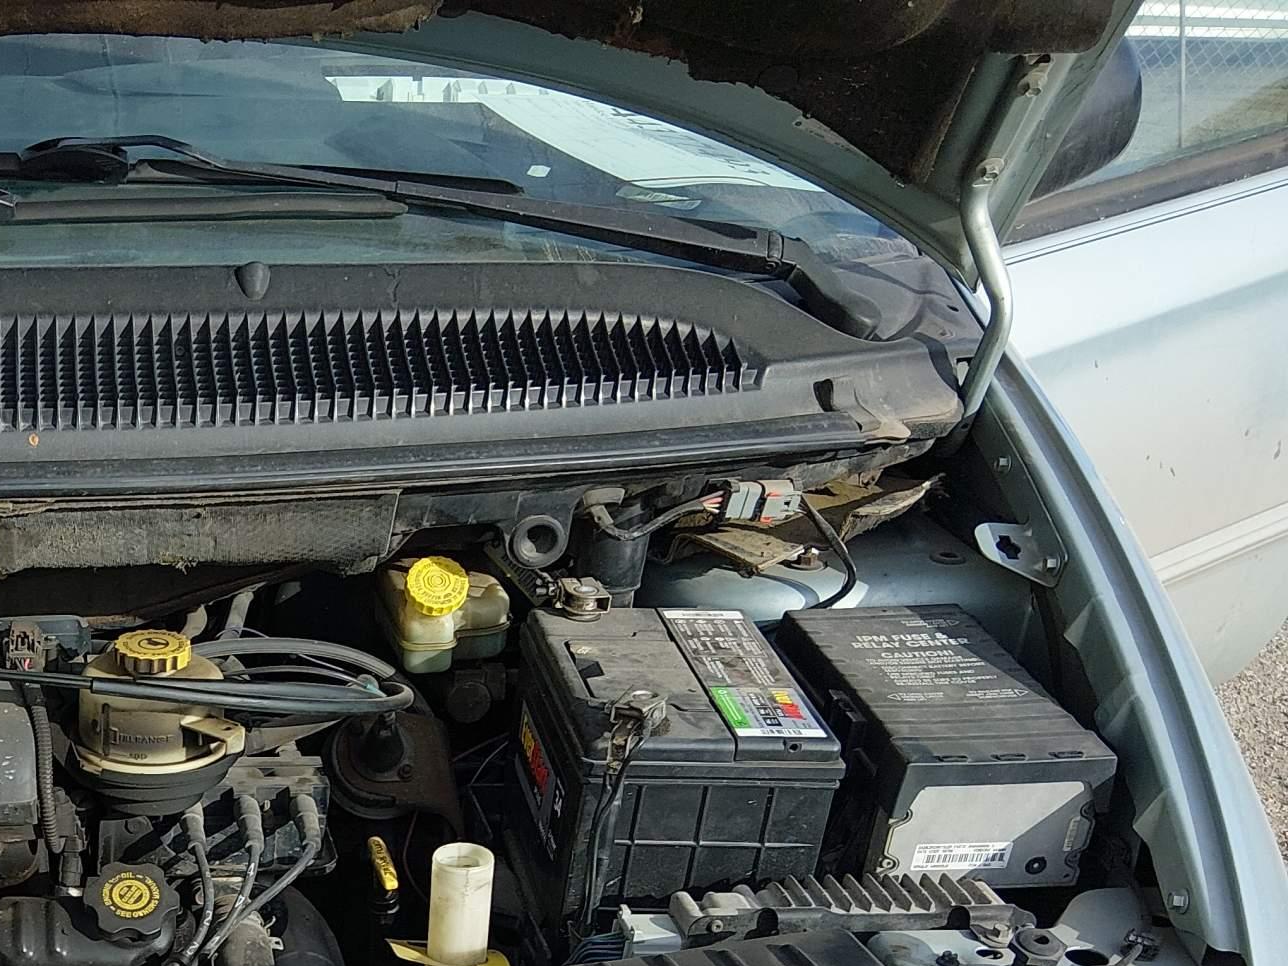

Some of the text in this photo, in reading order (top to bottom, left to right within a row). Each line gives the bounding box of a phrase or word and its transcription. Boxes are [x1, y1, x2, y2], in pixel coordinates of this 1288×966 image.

[855, 634, 890, 642] IPM
[891, 633, 929, 641] FUSE
[851, 638, 970, 649] RELAY CENTER
